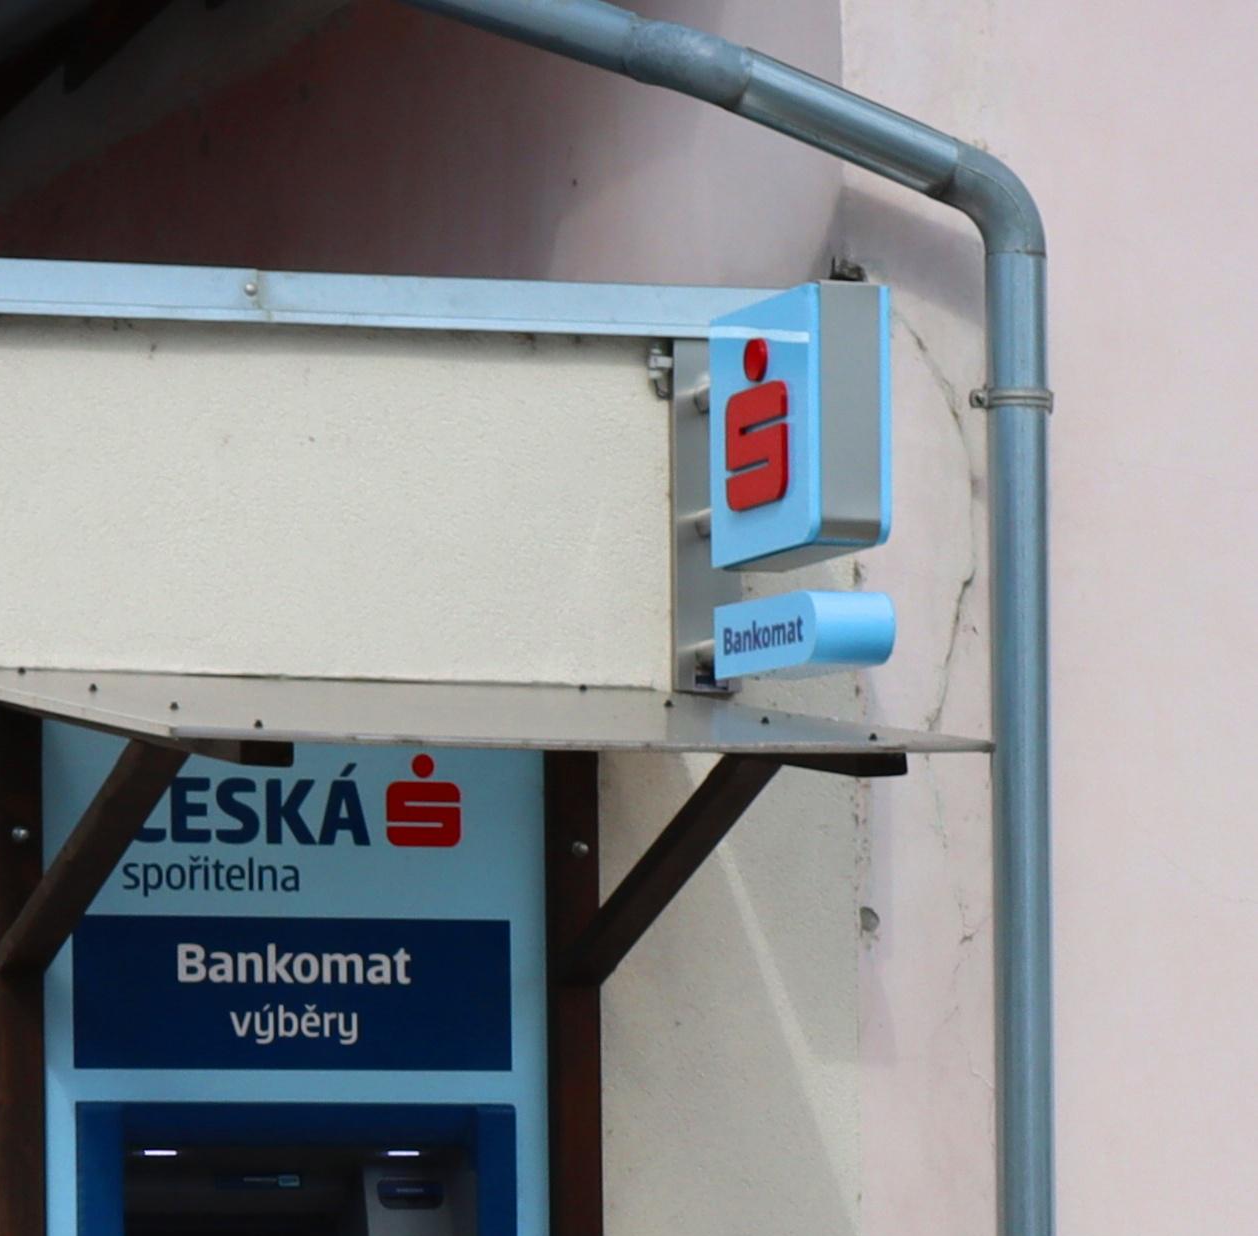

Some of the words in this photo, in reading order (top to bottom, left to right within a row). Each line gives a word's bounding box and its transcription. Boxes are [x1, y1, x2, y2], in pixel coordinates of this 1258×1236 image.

[722, 615, 805, 657] Bankomat
[132, 762, 371, 847] ESKÁ
[121, 855, 301, 898] spořitelna
[176, 942, 412, 986] Bankomat
[229, 1003, 359, 1045] výběry
